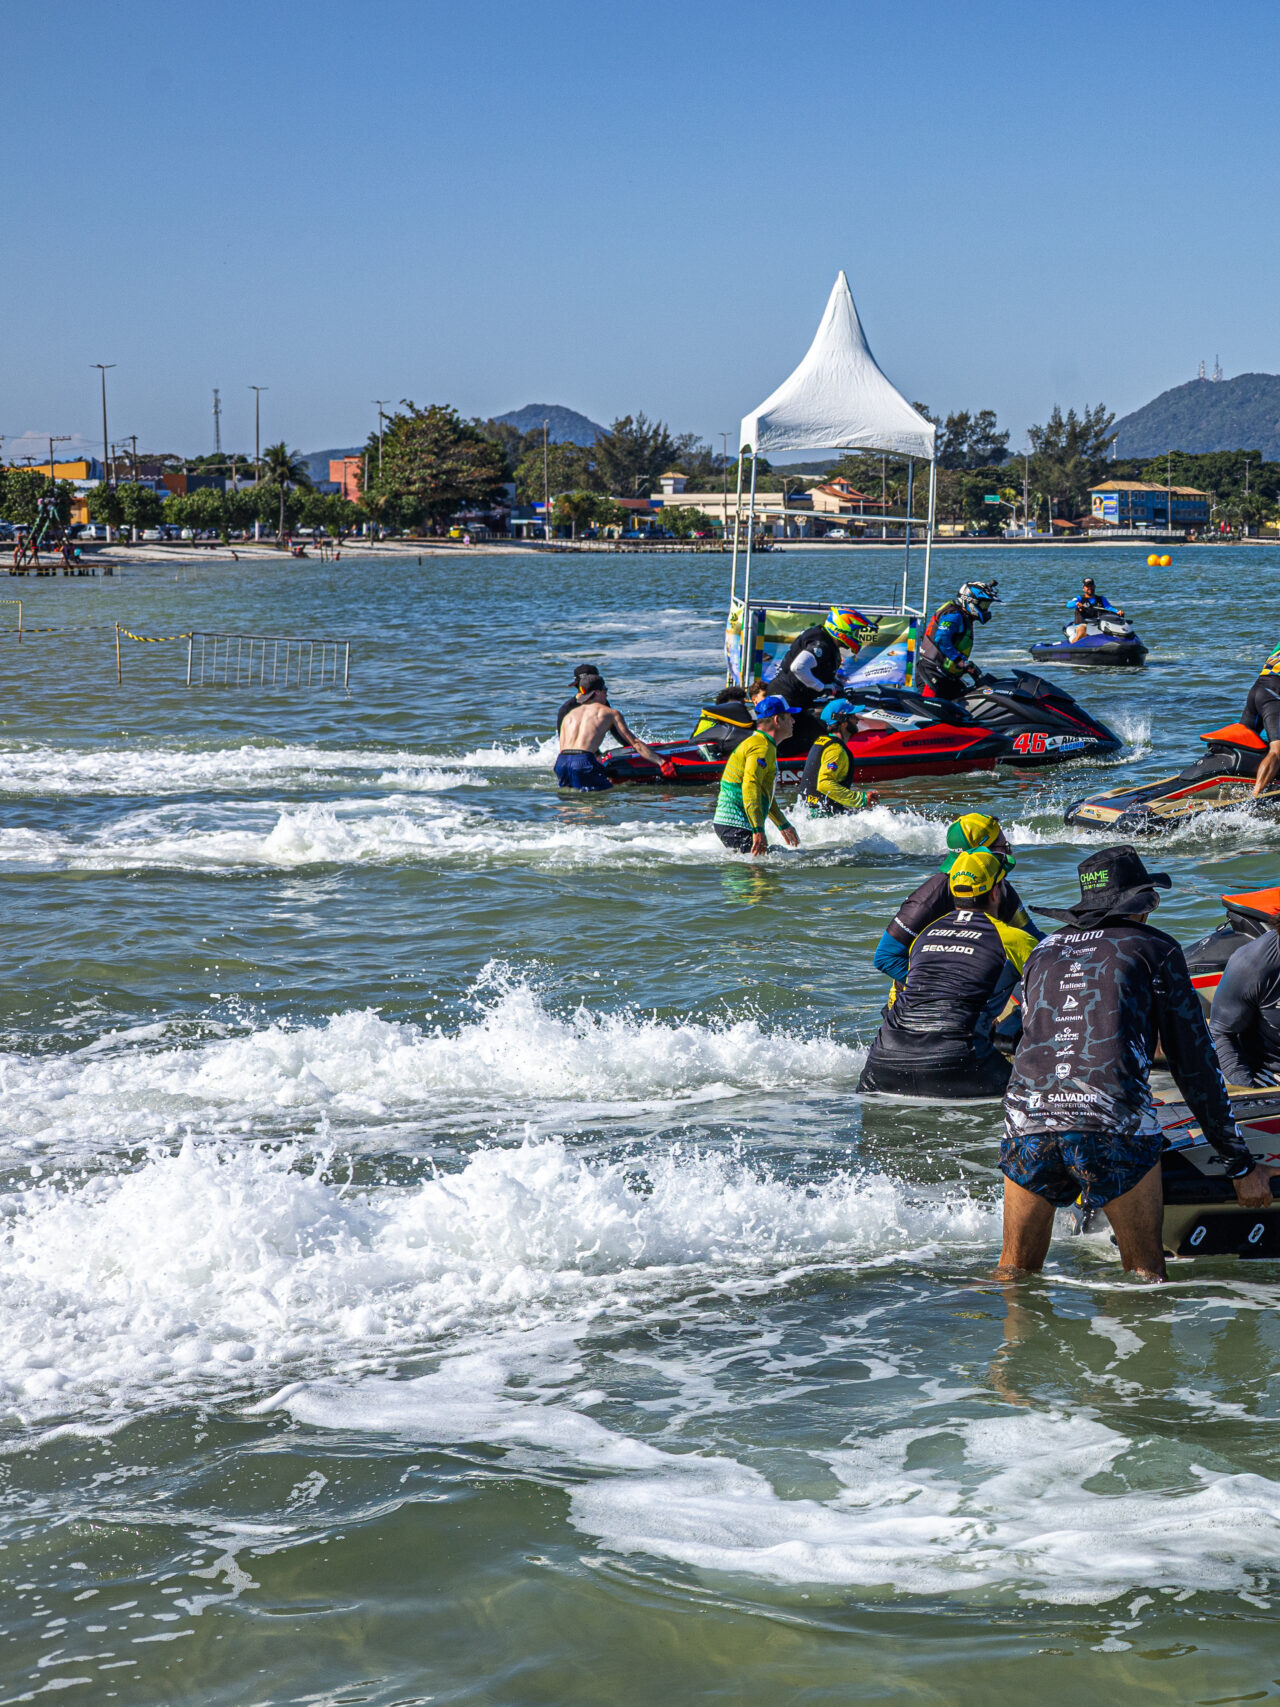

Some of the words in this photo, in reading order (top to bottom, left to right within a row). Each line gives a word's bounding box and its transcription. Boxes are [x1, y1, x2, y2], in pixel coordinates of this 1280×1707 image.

[1013, 732, 1048, 754] 46
[1080, 869, 1109, 883] CHAME
[927, 928, 982, 940] can-am
[1064, 930, 1104, 943] PILOTO
[1048, 1093, 1098, 1103] SALVADOR
